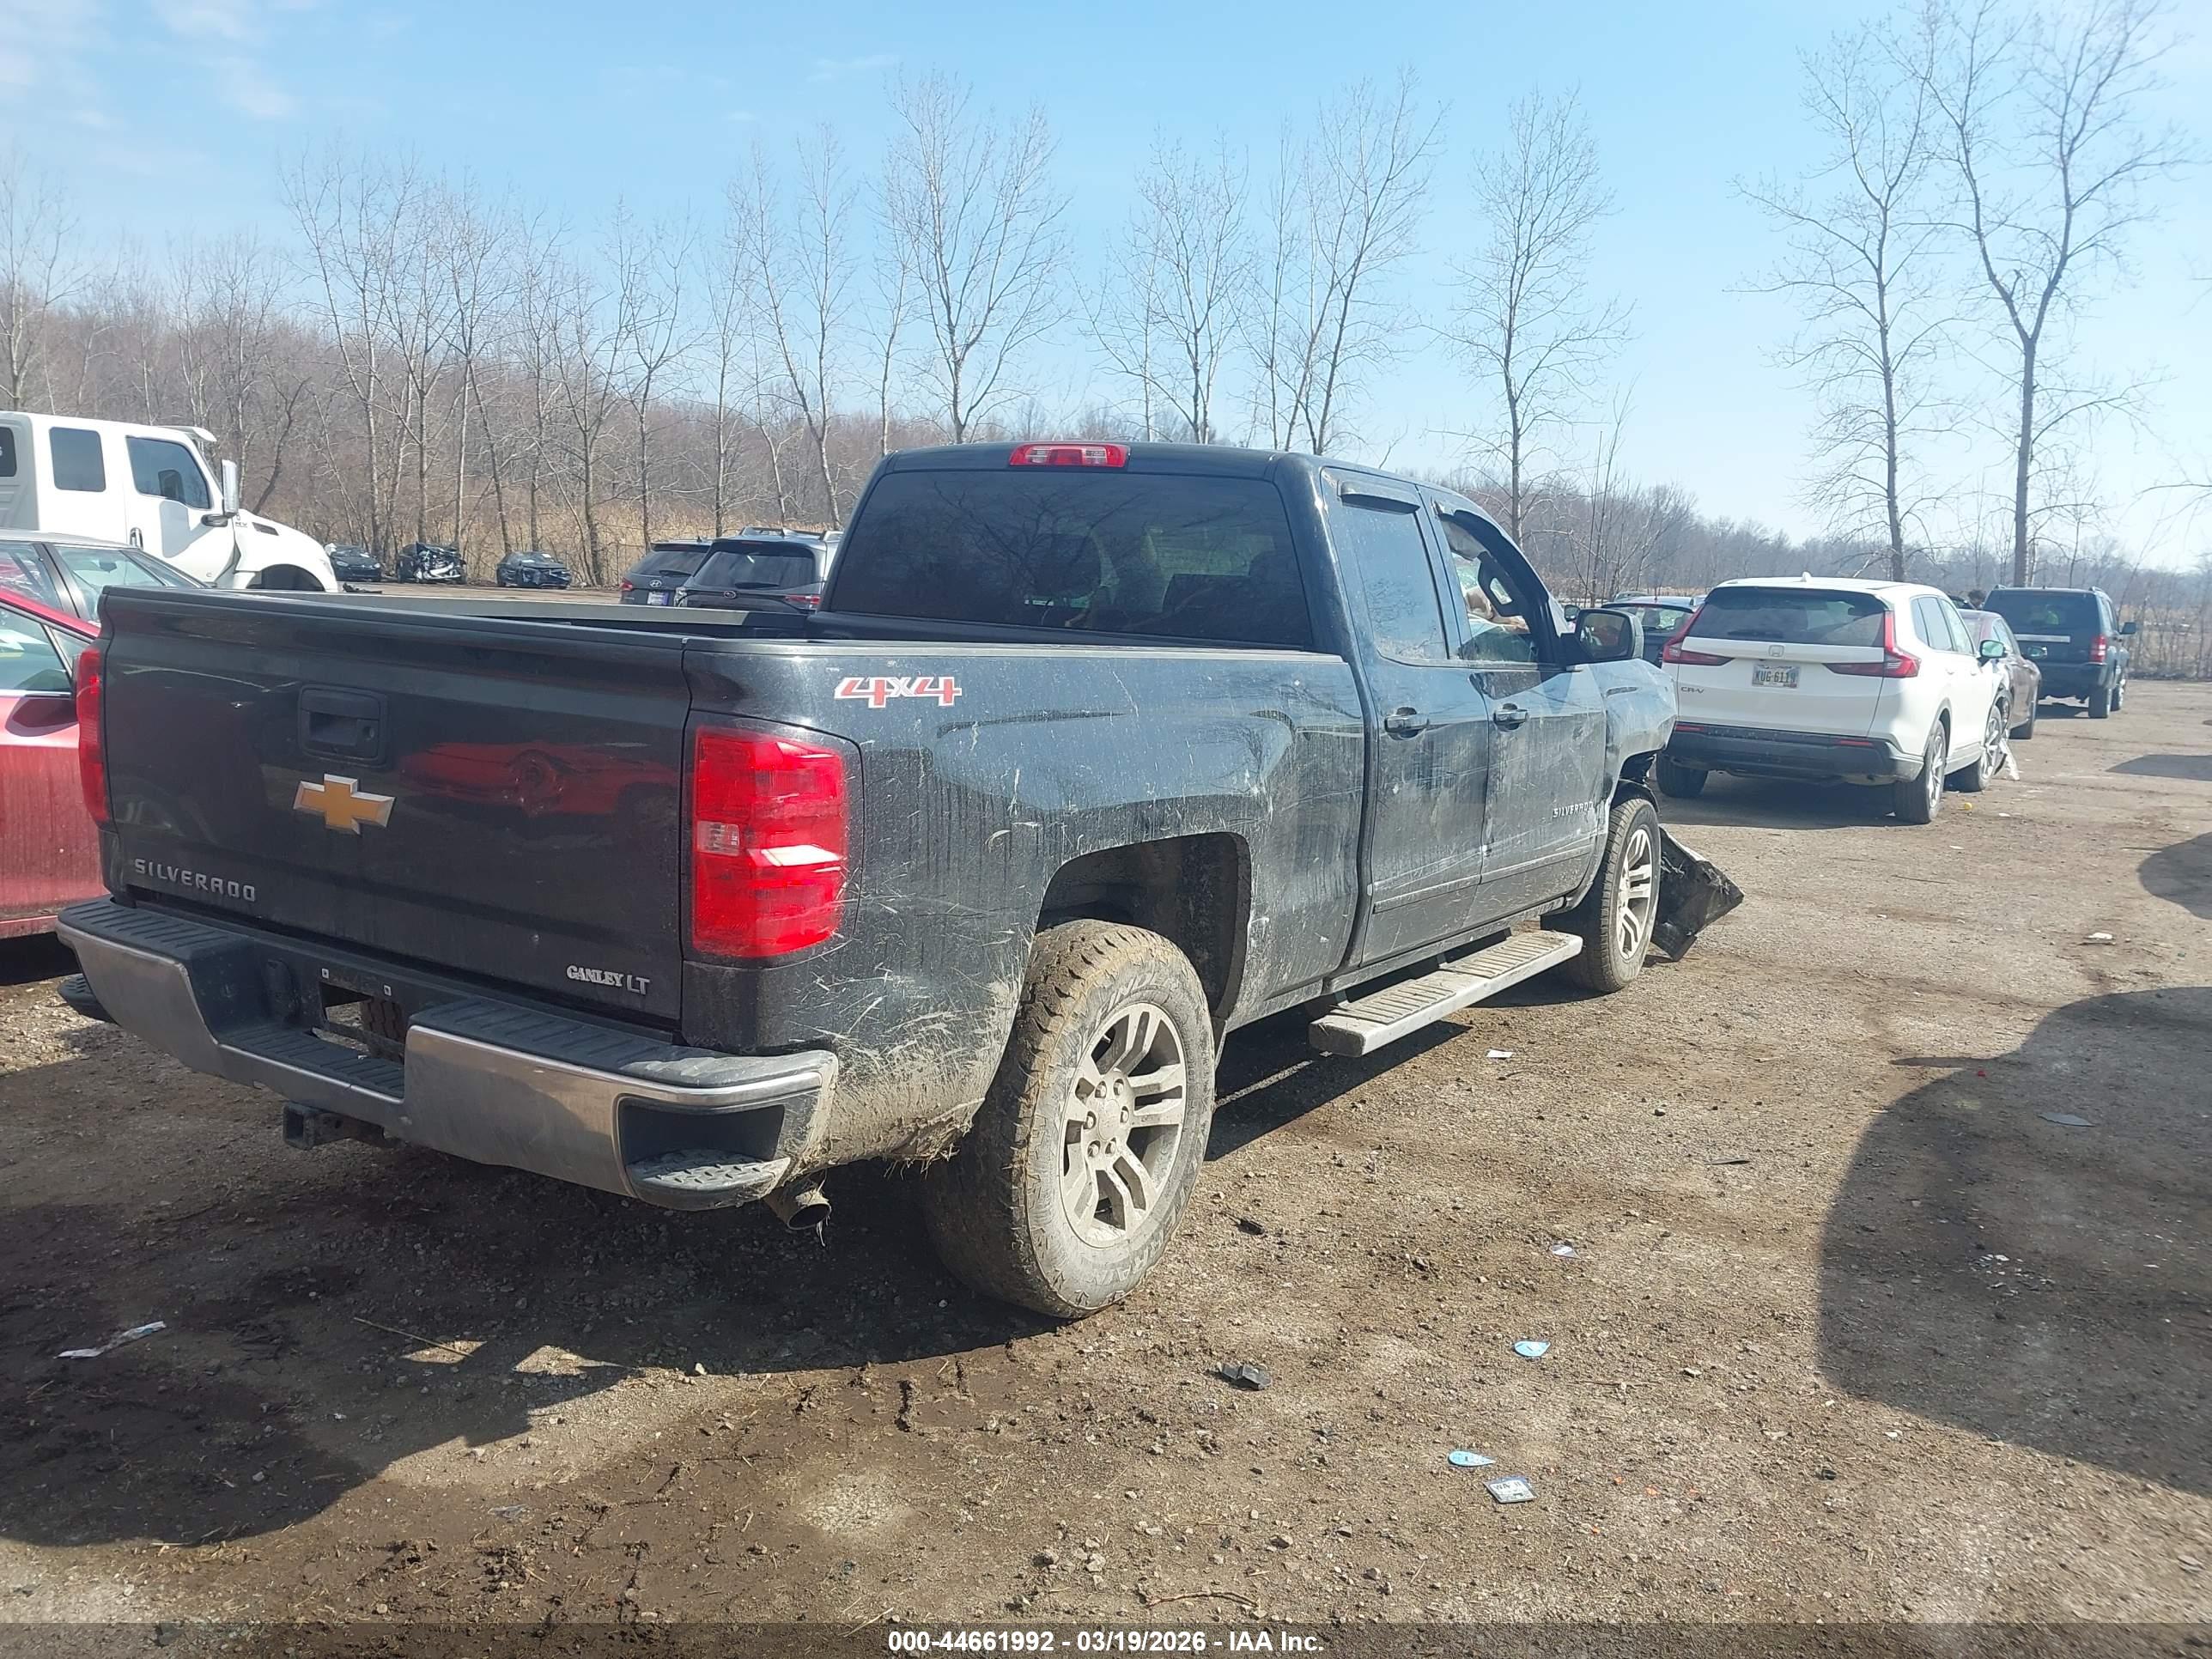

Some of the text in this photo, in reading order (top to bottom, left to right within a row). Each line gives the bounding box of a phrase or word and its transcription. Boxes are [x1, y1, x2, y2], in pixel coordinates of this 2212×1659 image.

[134, 858, 255, 902] SILVERADO
[567, 965, 651, 995] GANLEY LT
